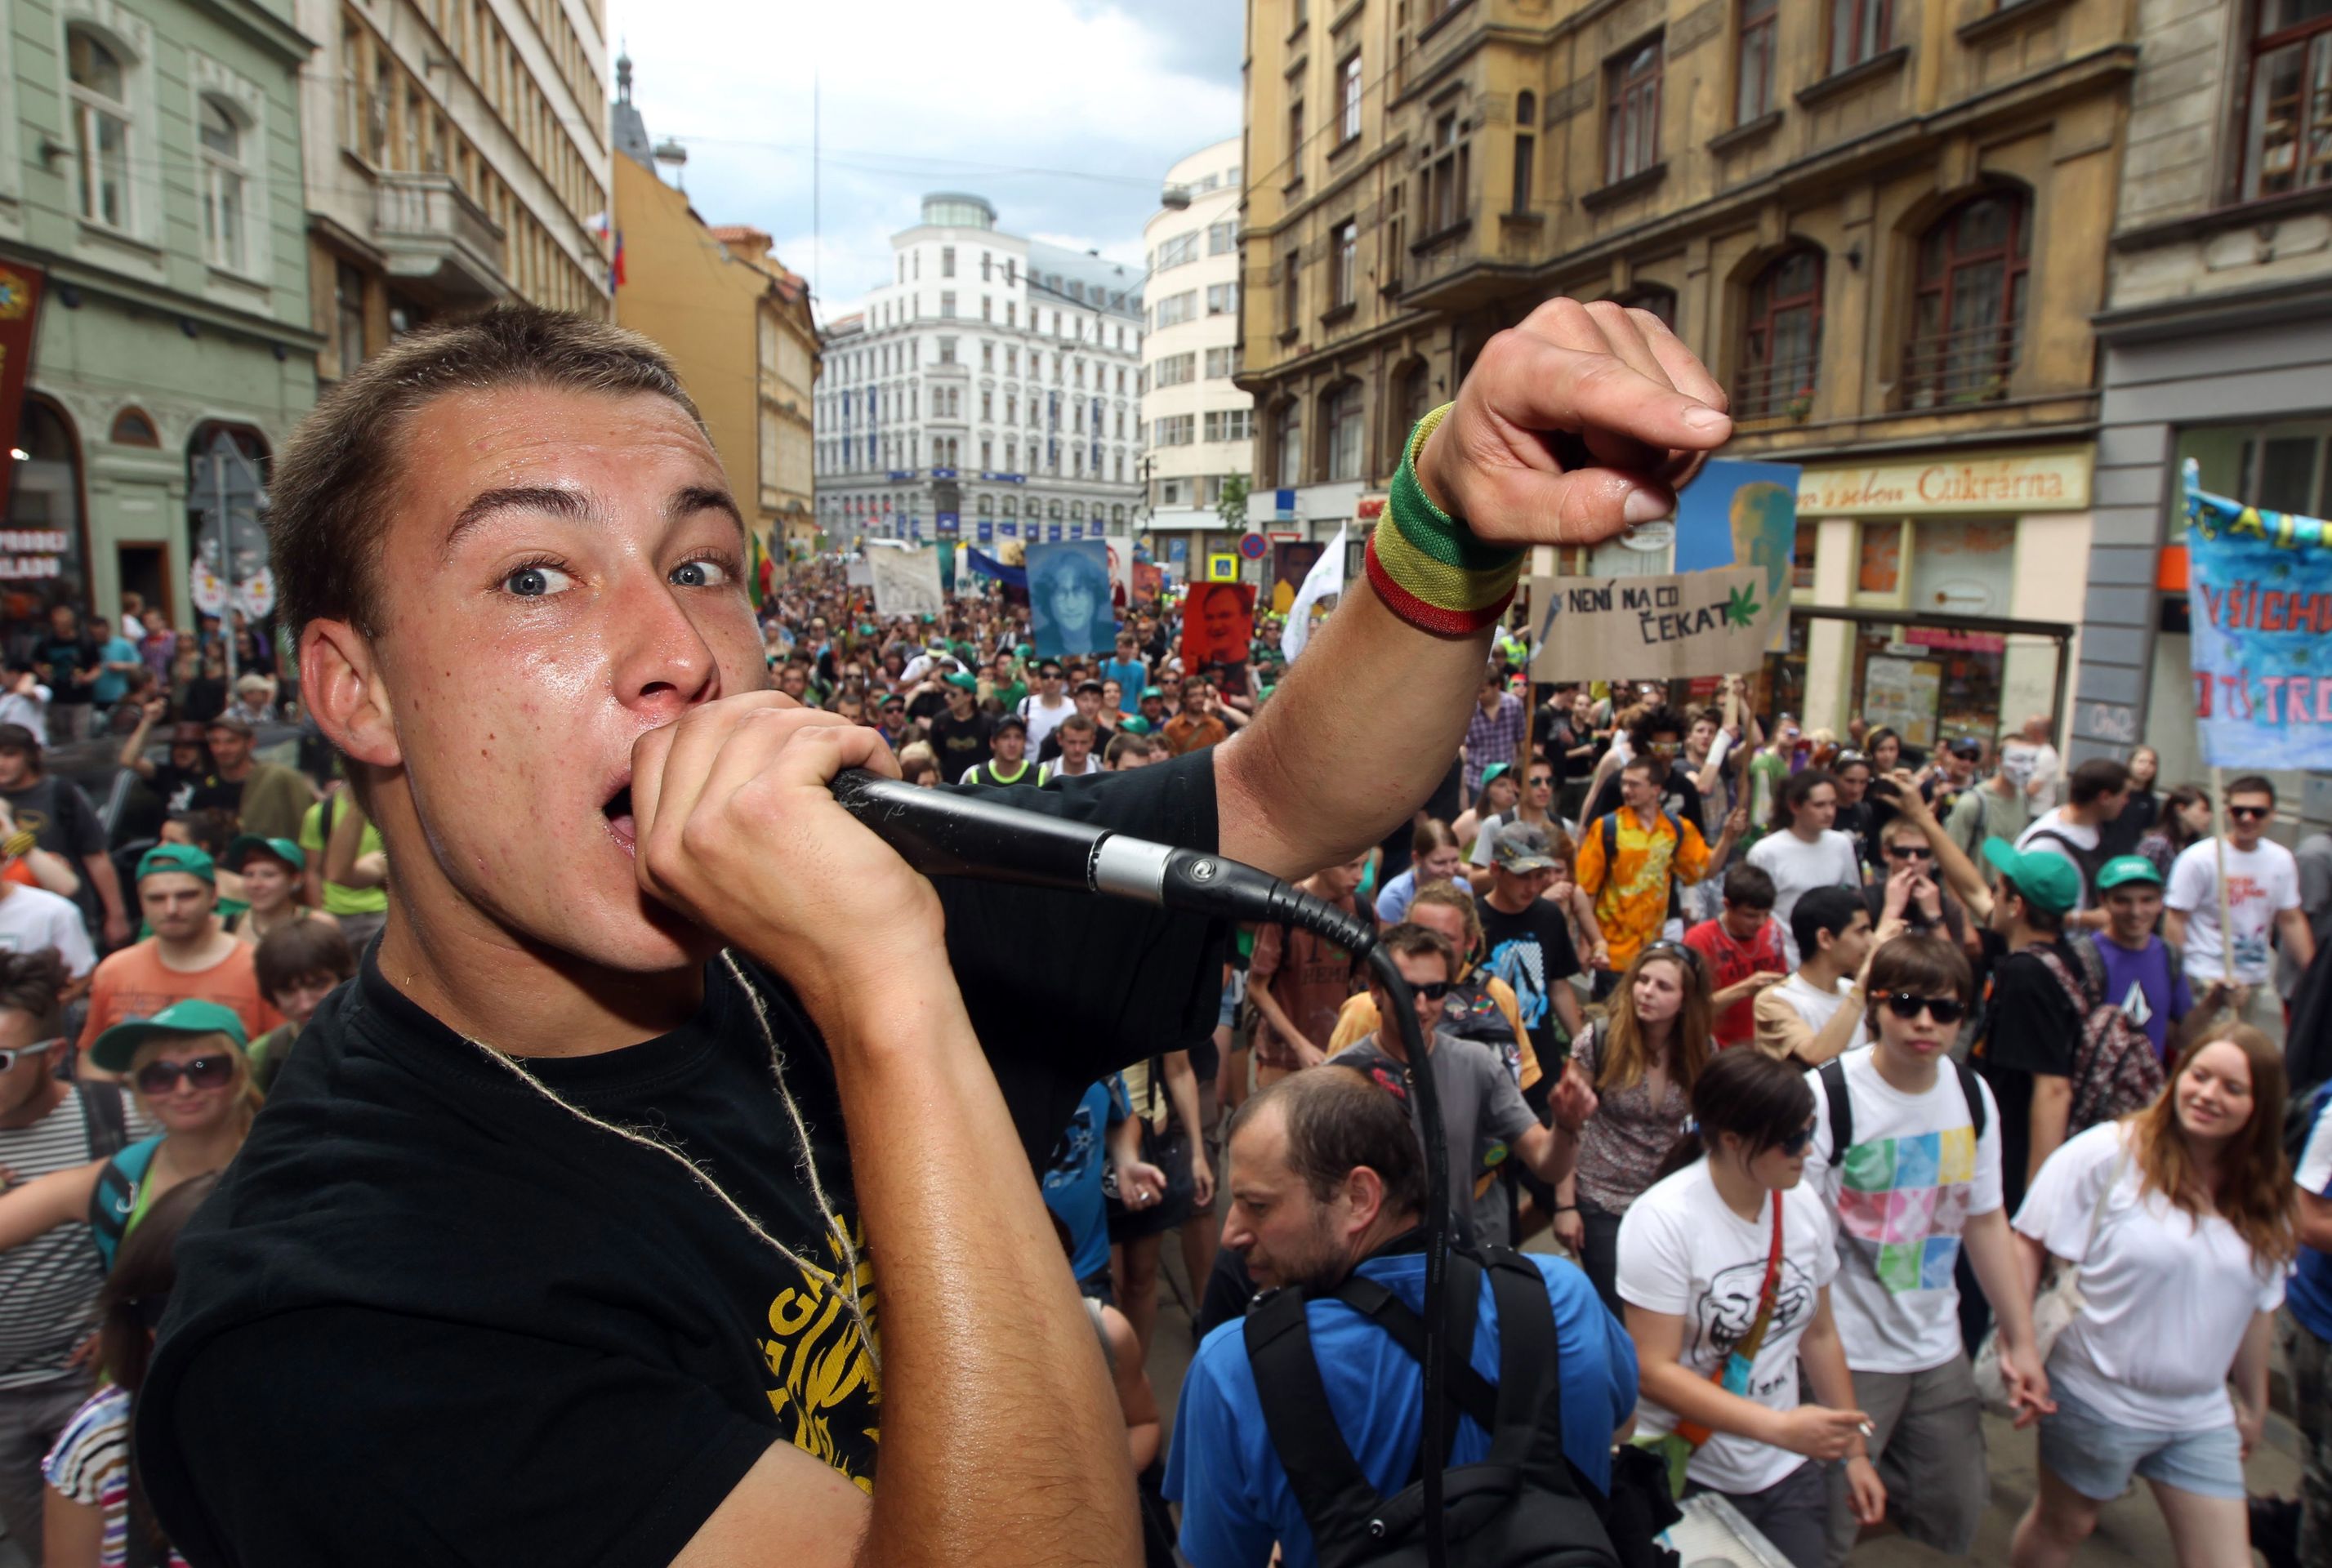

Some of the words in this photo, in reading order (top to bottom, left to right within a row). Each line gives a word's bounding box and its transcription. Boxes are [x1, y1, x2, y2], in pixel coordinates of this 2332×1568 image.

[1917, 461, 2063, 505] Cukrárna
[1569, 578, 1616, 613] NENÍ
[1622, 587, 1651, 610] NA
[1638, 600, 1735, 644] ČEKAT
